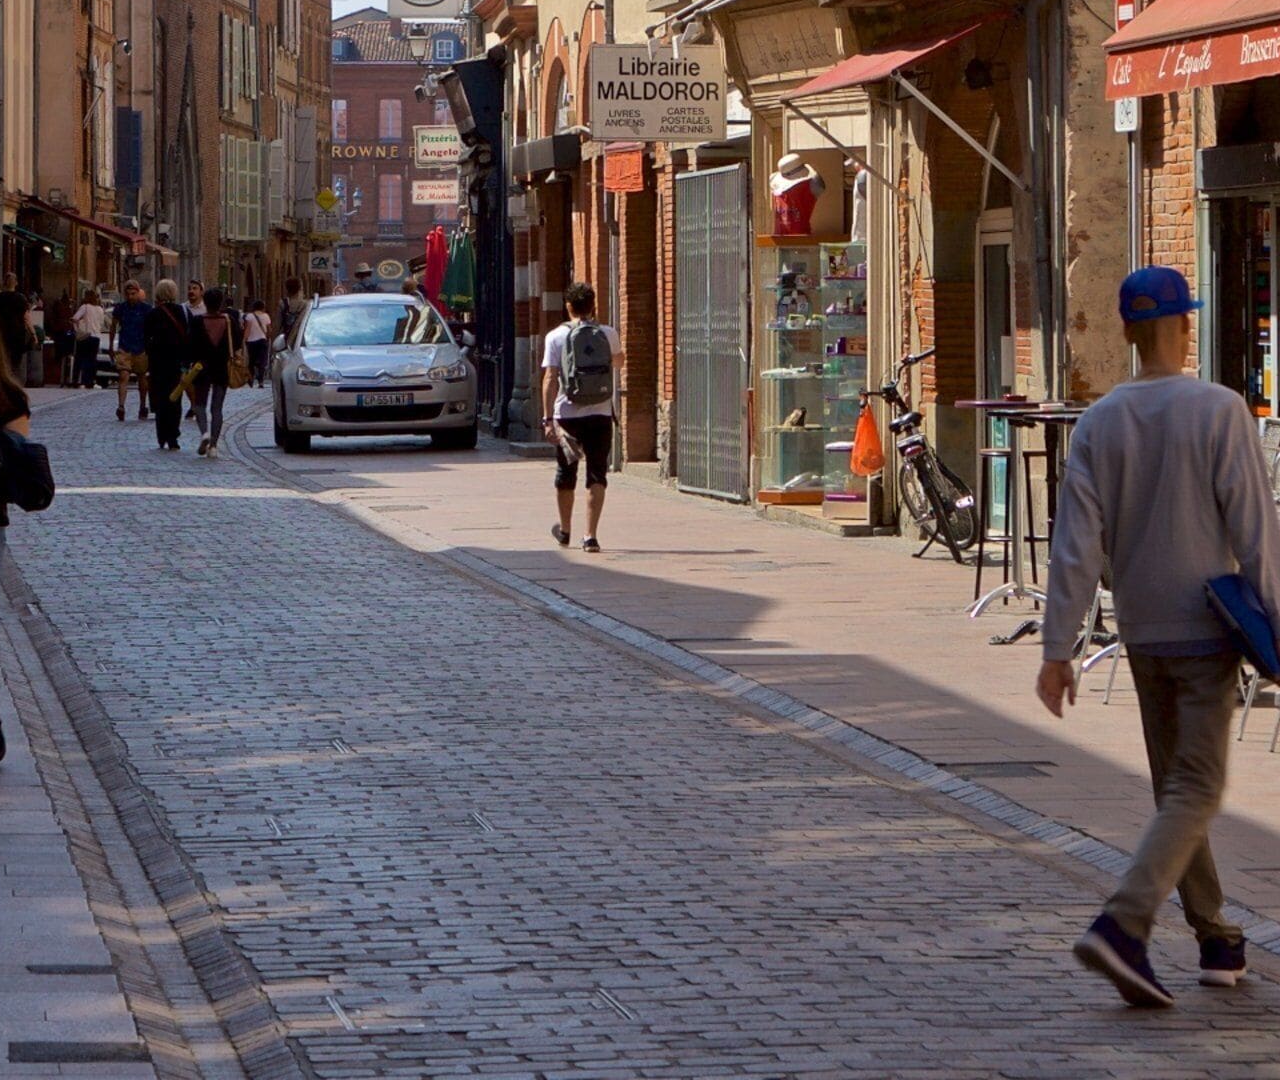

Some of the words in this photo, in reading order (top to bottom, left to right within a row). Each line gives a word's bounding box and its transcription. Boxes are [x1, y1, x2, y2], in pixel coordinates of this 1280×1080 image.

[619, 56, 701, 77] Librairie
[597, 81, 720, 101] MALDOROR
[609, 109, 641, 118] LIVRES
[666, 107, 705, 116] CARTES
[604, 119, 646, 128] ANCIENS
[661, 116, 710, 125] POSTALES
[659, 125, 713, 134] ANCIENNES
[331, 146, 399, 159] ROWNE
[421, 147, 459, 158] Angelo
